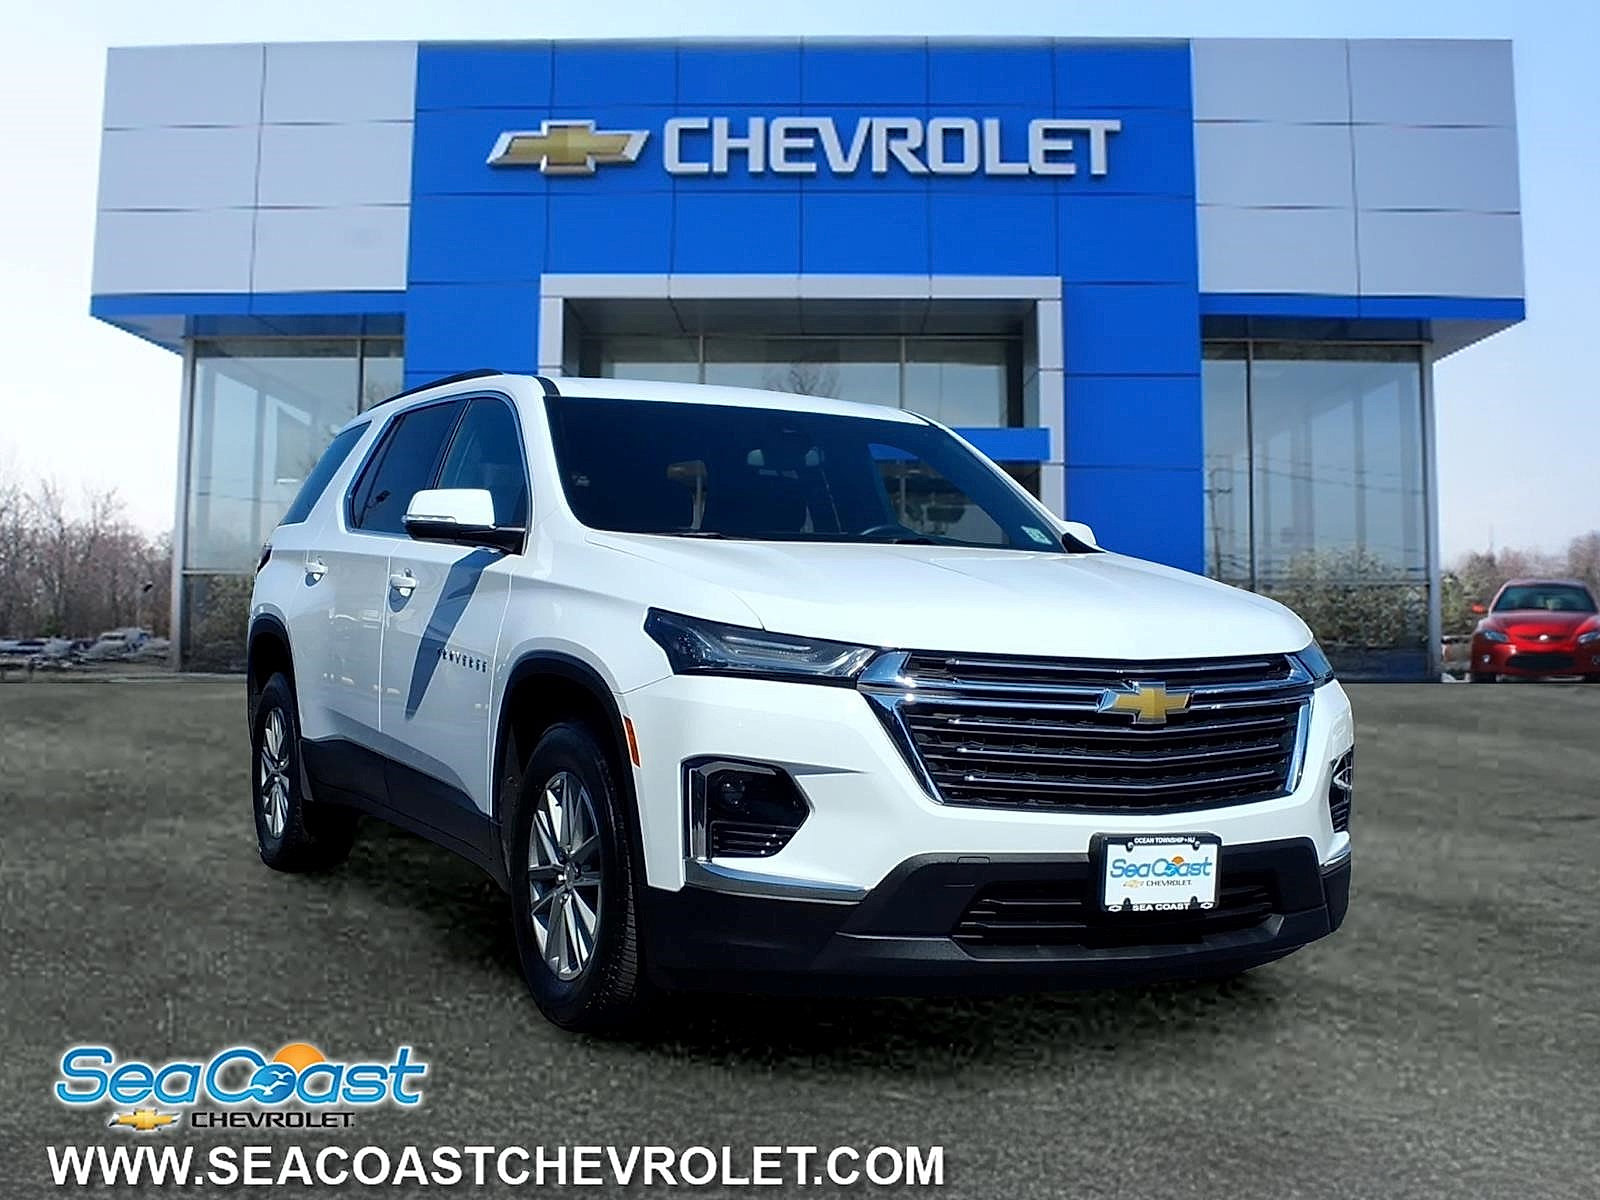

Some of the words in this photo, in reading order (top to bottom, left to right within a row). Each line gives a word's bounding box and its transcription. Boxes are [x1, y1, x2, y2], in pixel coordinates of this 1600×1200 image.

[663, 117, 1121, 176] CHEVROLET
[1146, 879, 1192, 887] CHEVROLET
[1132, 903, 1153, 911] SEA
[1155, 902, 1191, 911] COAST
